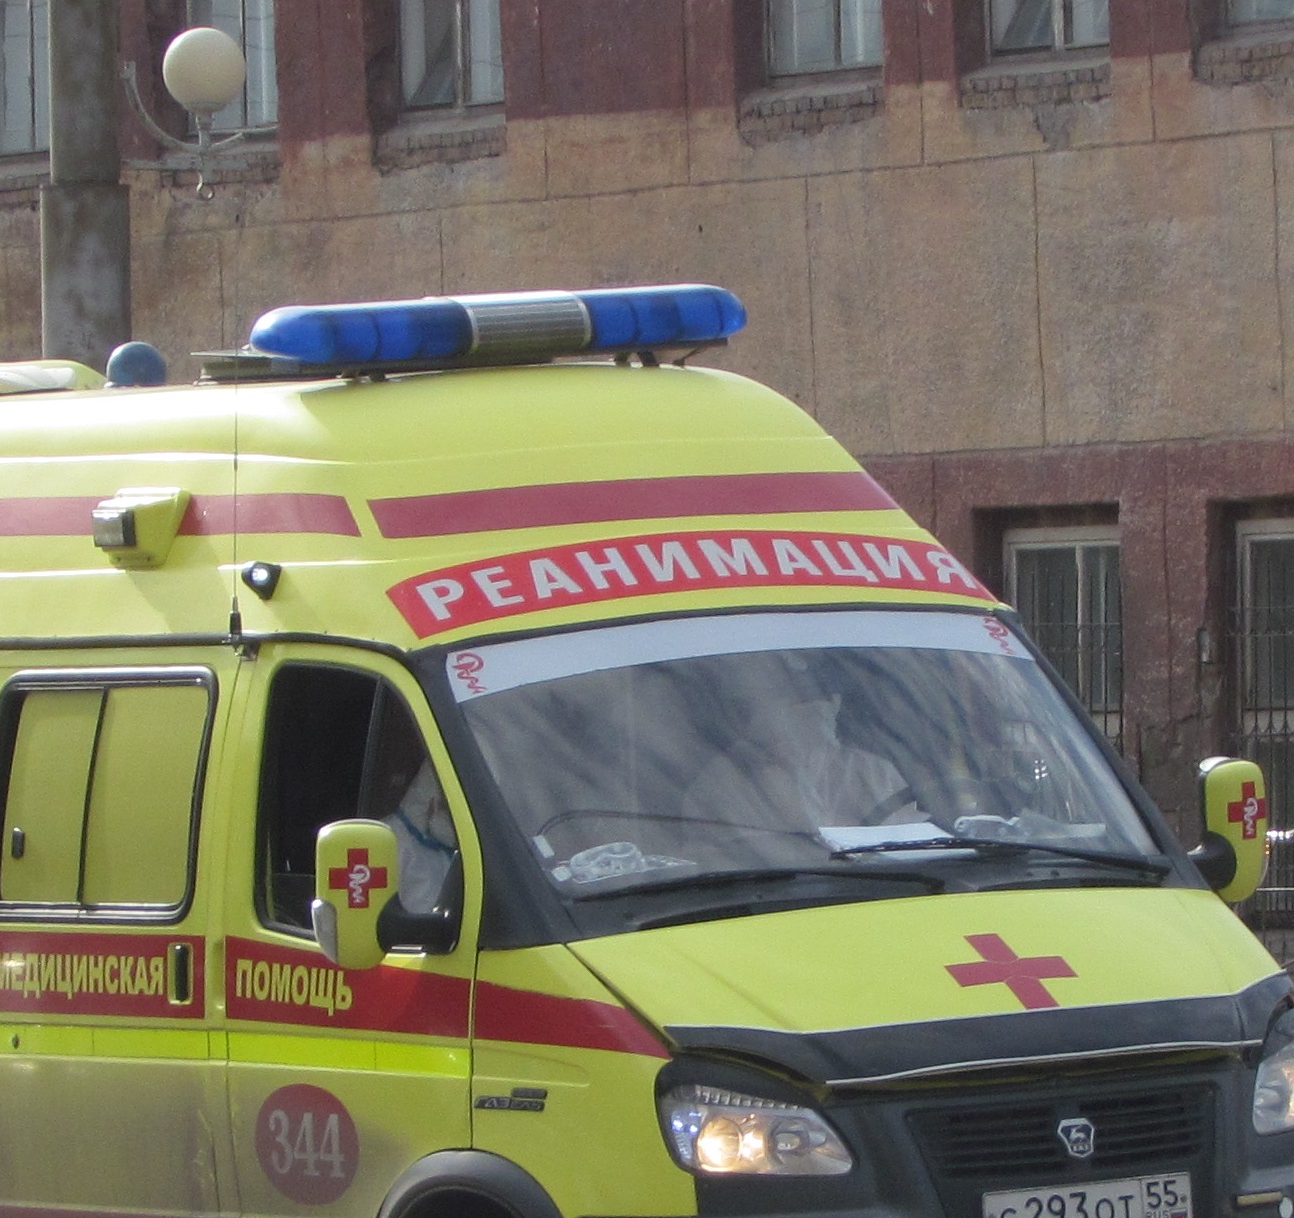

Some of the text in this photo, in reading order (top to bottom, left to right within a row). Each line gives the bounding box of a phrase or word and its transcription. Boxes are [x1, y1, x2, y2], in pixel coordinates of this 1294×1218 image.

[415, 537, 977, 621] РЕАНИМАЦИЯ
[236, 959, 353, 1016] ПОМОЩЬ
[268, 1109, 346, 1179] 344
[1147, 1180, 1178, 1209] 55
